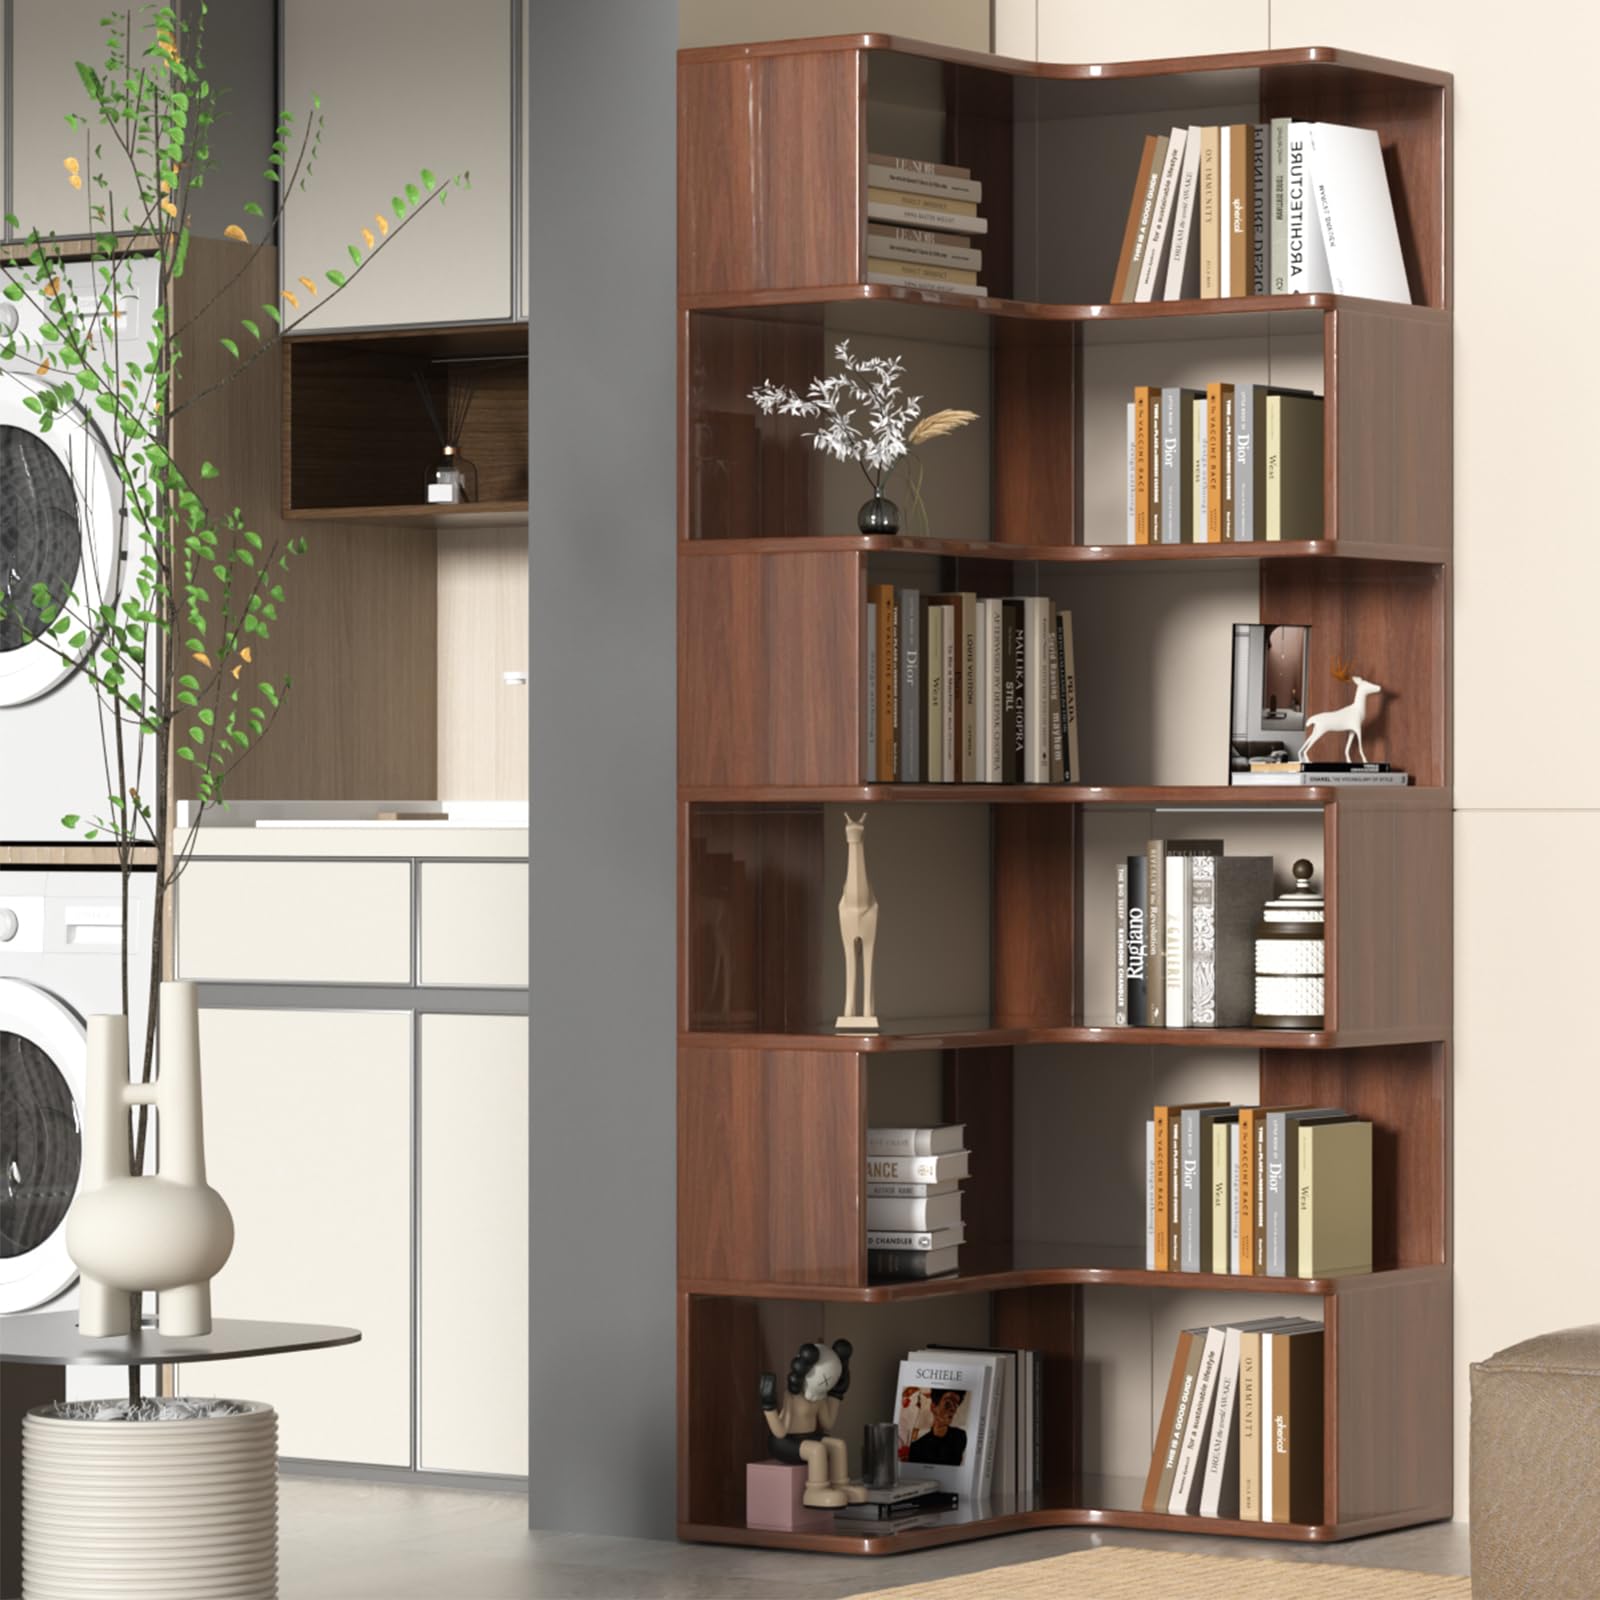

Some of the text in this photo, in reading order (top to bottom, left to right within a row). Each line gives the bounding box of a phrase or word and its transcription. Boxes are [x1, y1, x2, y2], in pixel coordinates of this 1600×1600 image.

[1205, 149, 1212, 162] ON
[1145, 172, 1158, 200] GUIDE
[1157, 180, 1171, 223] sustainable
[1165, 149, 1178, 178] lifestyle
[1141, 200, 1151, 225] GOOD
[1173, 230, 1185, 261] DREAM
[1183, 171, 1193, 202] AWAKE
[1232, 198, 1242, 234] spherical
[1133, 244, 1143, 262] THIS
[1164, 438, 1177, 468] Dior
[1237, 434, 1250, 464] Dior
[1269, 455, 1277, 479] West
[906, 651, 918, 686] Dior
[994, 676, 1001, 689] BY
[932, 677, 940, 707] West
[1005, 681, 1014, 712] STILL
[1015, 629, 1024, 751] MALLIKA CHOPRA
[1052, 713, 1062, 761] mayhem
[1126, 908, 1147, 980] Rugiano
[1150, 906, 1158, 956] Revolution
[868, 1162, 898, 1178] ANCE
[1183, 1160, 1196, 1190] Dior
[1269, 1163, 1281, 1193] Dior
[1215, 1183, 1223, 1207] West
[1301, 1186, 1309, 1211] West
[916, 1368, 963, 1381] SCHIELE
[1187, 1438, 1195, 1450] for
[1192, 1383, 1208, 1429] sustainable
[1201, 1350, 1216, 1382] lifestyle
[1220, 1377, 1232, 1410] AWAKE
[1245, 1357, 1253, 1439] ON IMMUNITY
[1166, 1449, 1177, 1469] THIS
[1175, 1403, 1186, 1430] GOOD
[1181, 1375, 1192, 1402] GUIDE
[1217, 1410, 1226, 1429] world
[1274, 1415, 1286, 1453] spherical
[1210, 1439, 1223, 1474] DREAM
